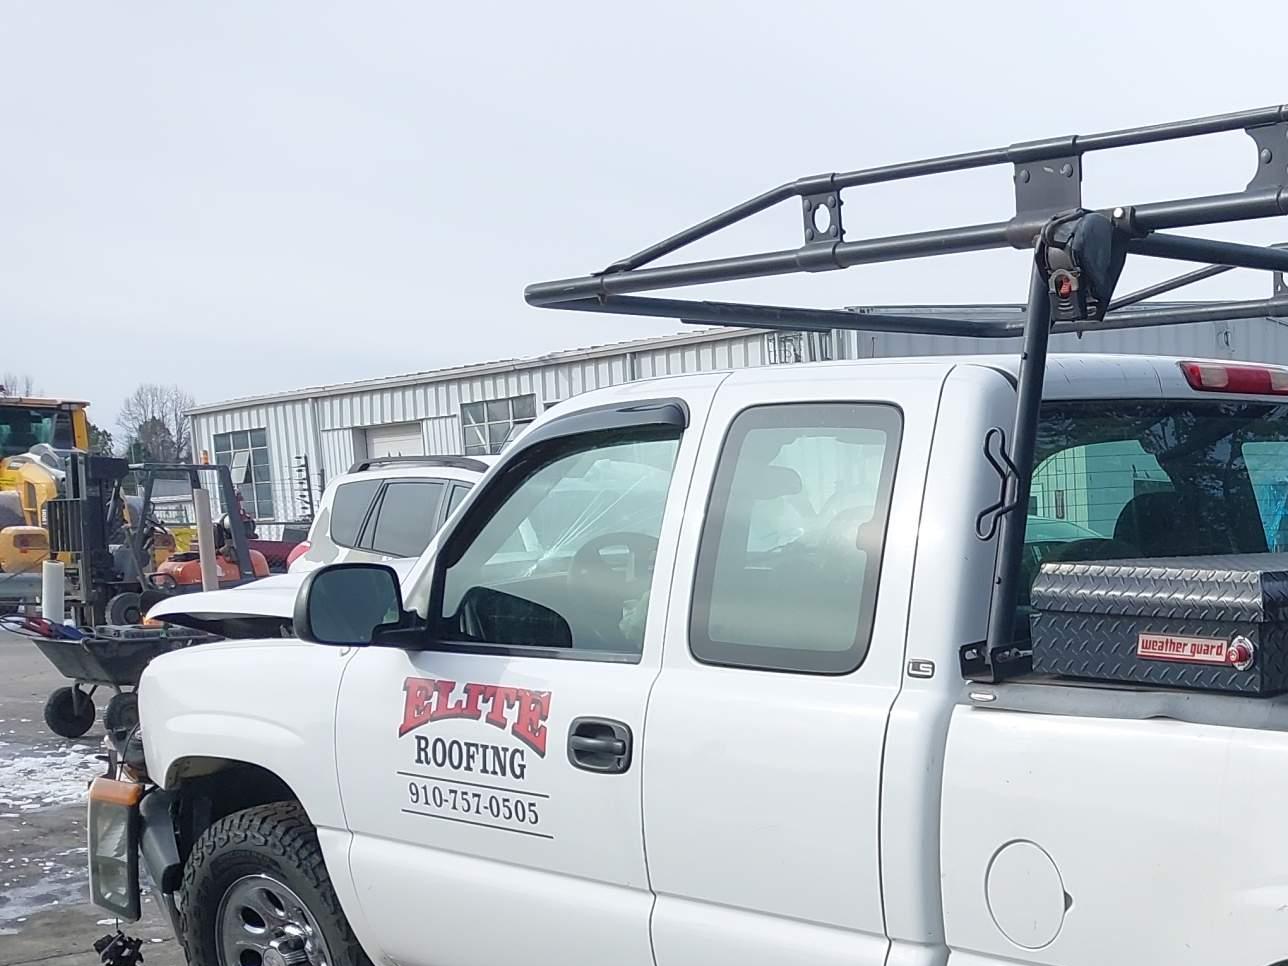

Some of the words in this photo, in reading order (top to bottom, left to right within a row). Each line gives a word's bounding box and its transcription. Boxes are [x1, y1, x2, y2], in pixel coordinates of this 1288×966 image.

[1141, 638, 1188, 653] weather
[1189, 642, 1224, 657] guard
[398, 676, 552, 759] ELITE
[415, 735, 527, 780] ROOFING
[408, 782, 539, 825] 910-757-0505
